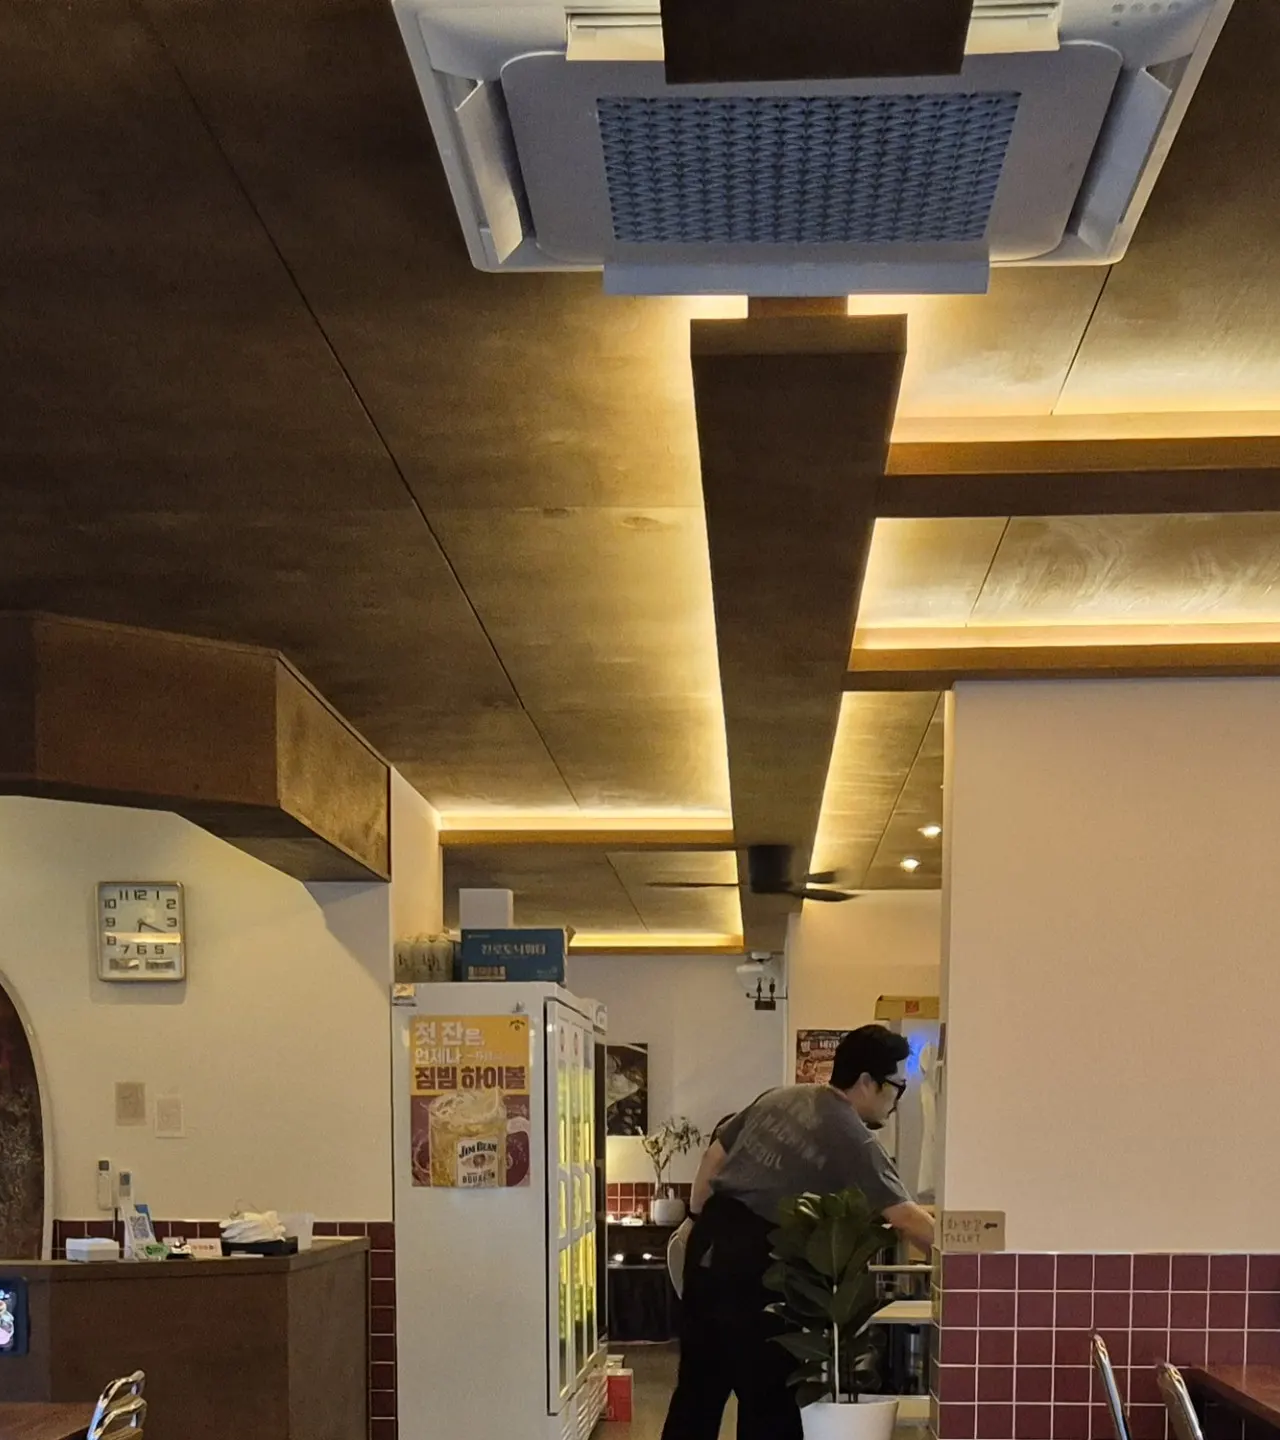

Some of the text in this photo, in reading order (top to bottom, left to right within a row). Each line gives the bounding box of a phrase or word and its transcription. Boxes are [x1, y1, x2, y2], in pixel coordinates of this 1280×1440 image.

[120, 890, 129, 901] 11
[134, 889, 148, 900] 12
[104, 898, 117, 909] 10
[166, 899, 177, 910] 2
[105, 917, 116, 928] 9
[167, 917, 178, 928] 3
[120, 944, 130, 955] 7
[137, 944, 147, 955] 6
[154, 944, 165, 955] 5
[415, 1020, 437, 1047] 첫
[415, 1046, 463, 1065] 언제나
[414, 1065, 526, 1091] 짐빔 하이볼
[459, 1143, 476, 1159] JIM
